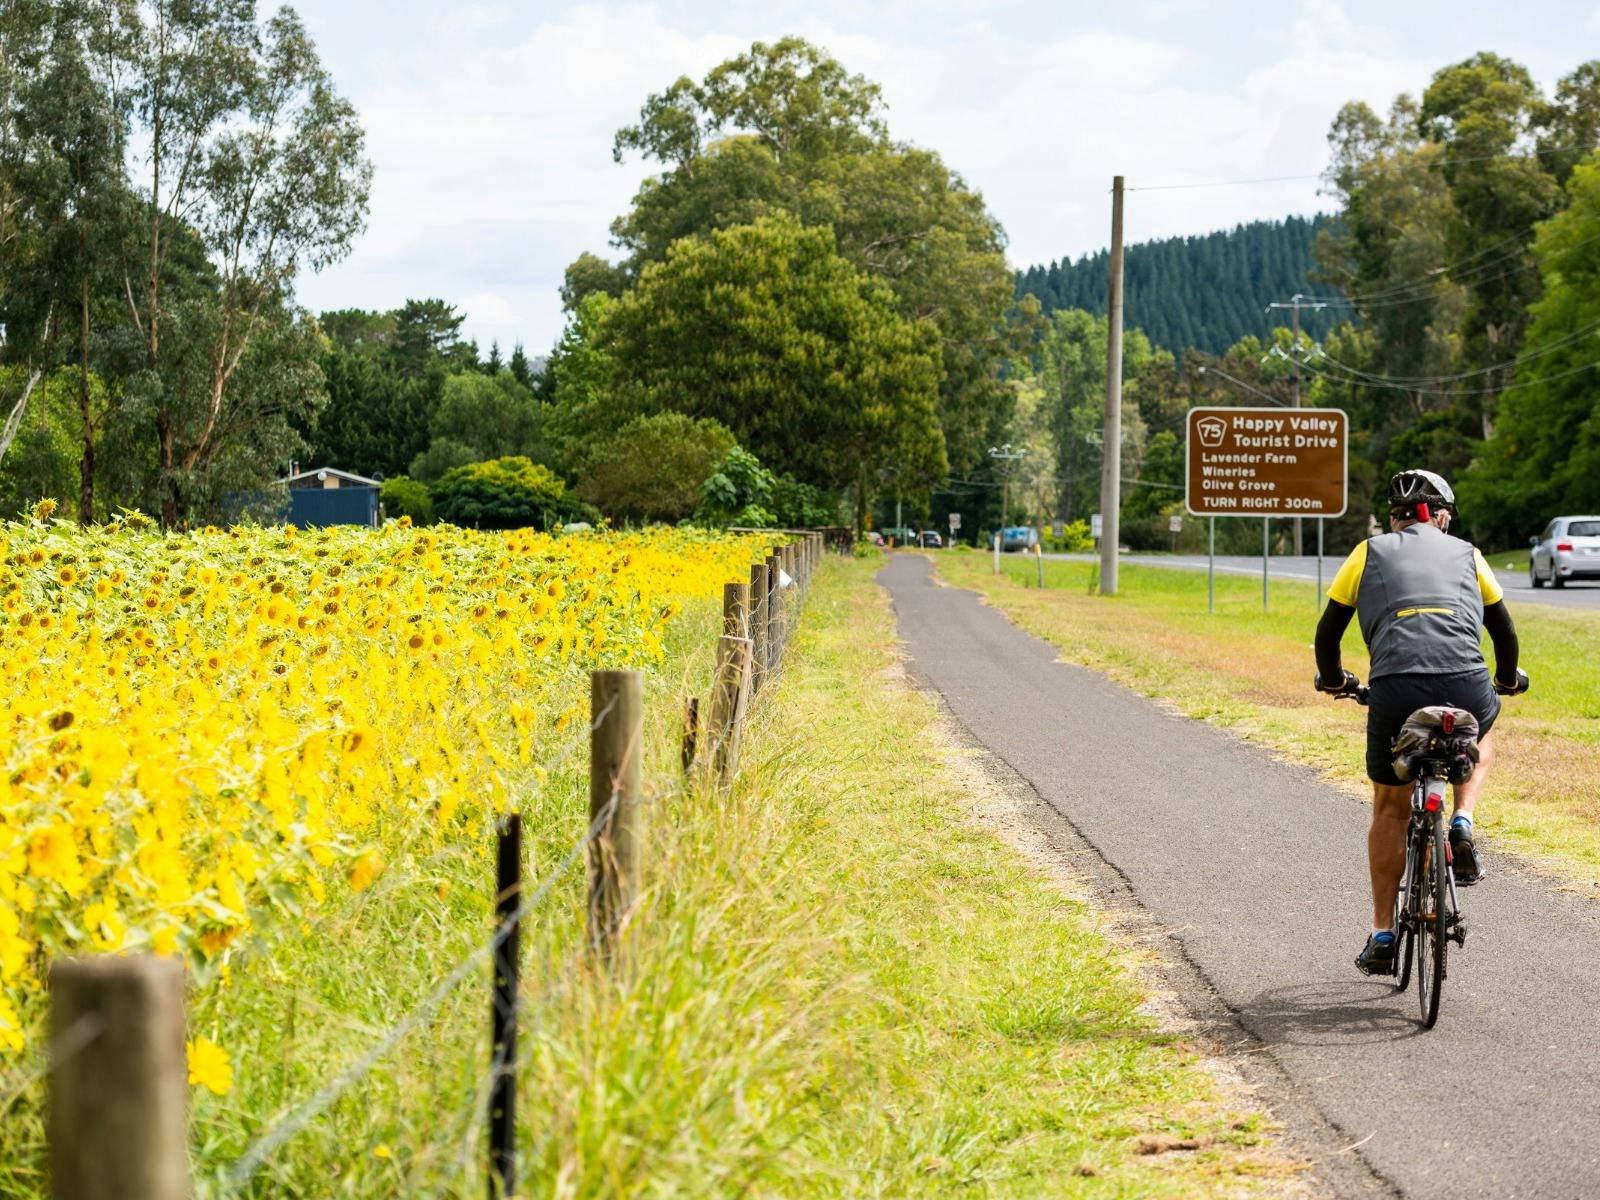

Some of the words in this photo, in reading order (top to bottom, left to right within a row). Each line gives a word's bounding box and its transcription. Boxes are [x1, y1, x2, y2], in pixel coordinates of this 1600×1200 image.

[1200, 424, 1221, 438] 75
[1233, 417, 1284, 432] Happy
[1290, 417, 1338, 433] Valley
[1234, 434, 1290, 447] Tourist
[1295, 435, 1338, 448] Drive
[1202, 453, 1261, 463] Lavender
[1265, 453, 1296, 464] Farm
[1202, 467, 1256, 477] Wineries
[1202, 480, 1234, 490] Olive
[1239, 480, 1275, 490] Grove
[1203, 497, 1236, 507] TURN
[1242, 497, 1280, 508] RIGHT
[1285, 498, 1322, 509] 300m
